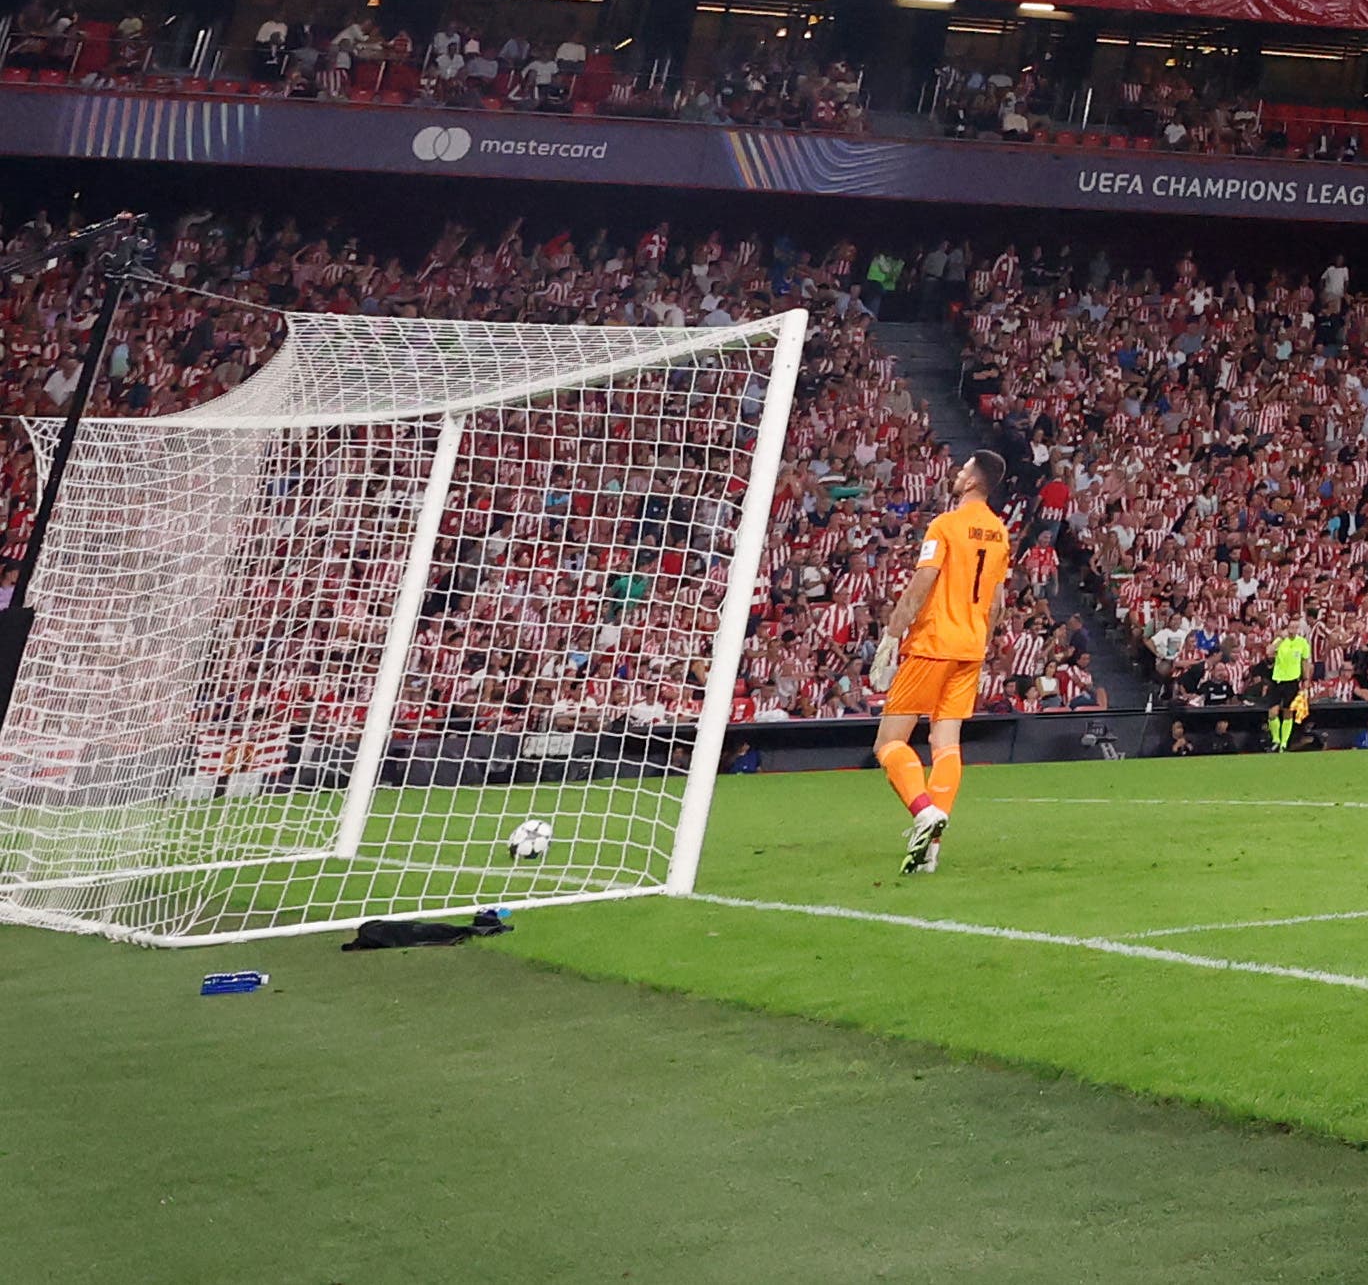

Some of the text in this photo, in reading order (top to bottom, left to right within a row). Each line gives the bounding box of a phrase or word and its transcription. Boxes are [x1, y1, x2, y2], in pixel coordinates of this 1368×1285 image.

[480, 139, 608, 159] mastercard
[1078, 170, 1144, 194] UEFA
[1152, 175, 1298, 202] CHAMPIONS
[973, 548, 986, 604] 1
